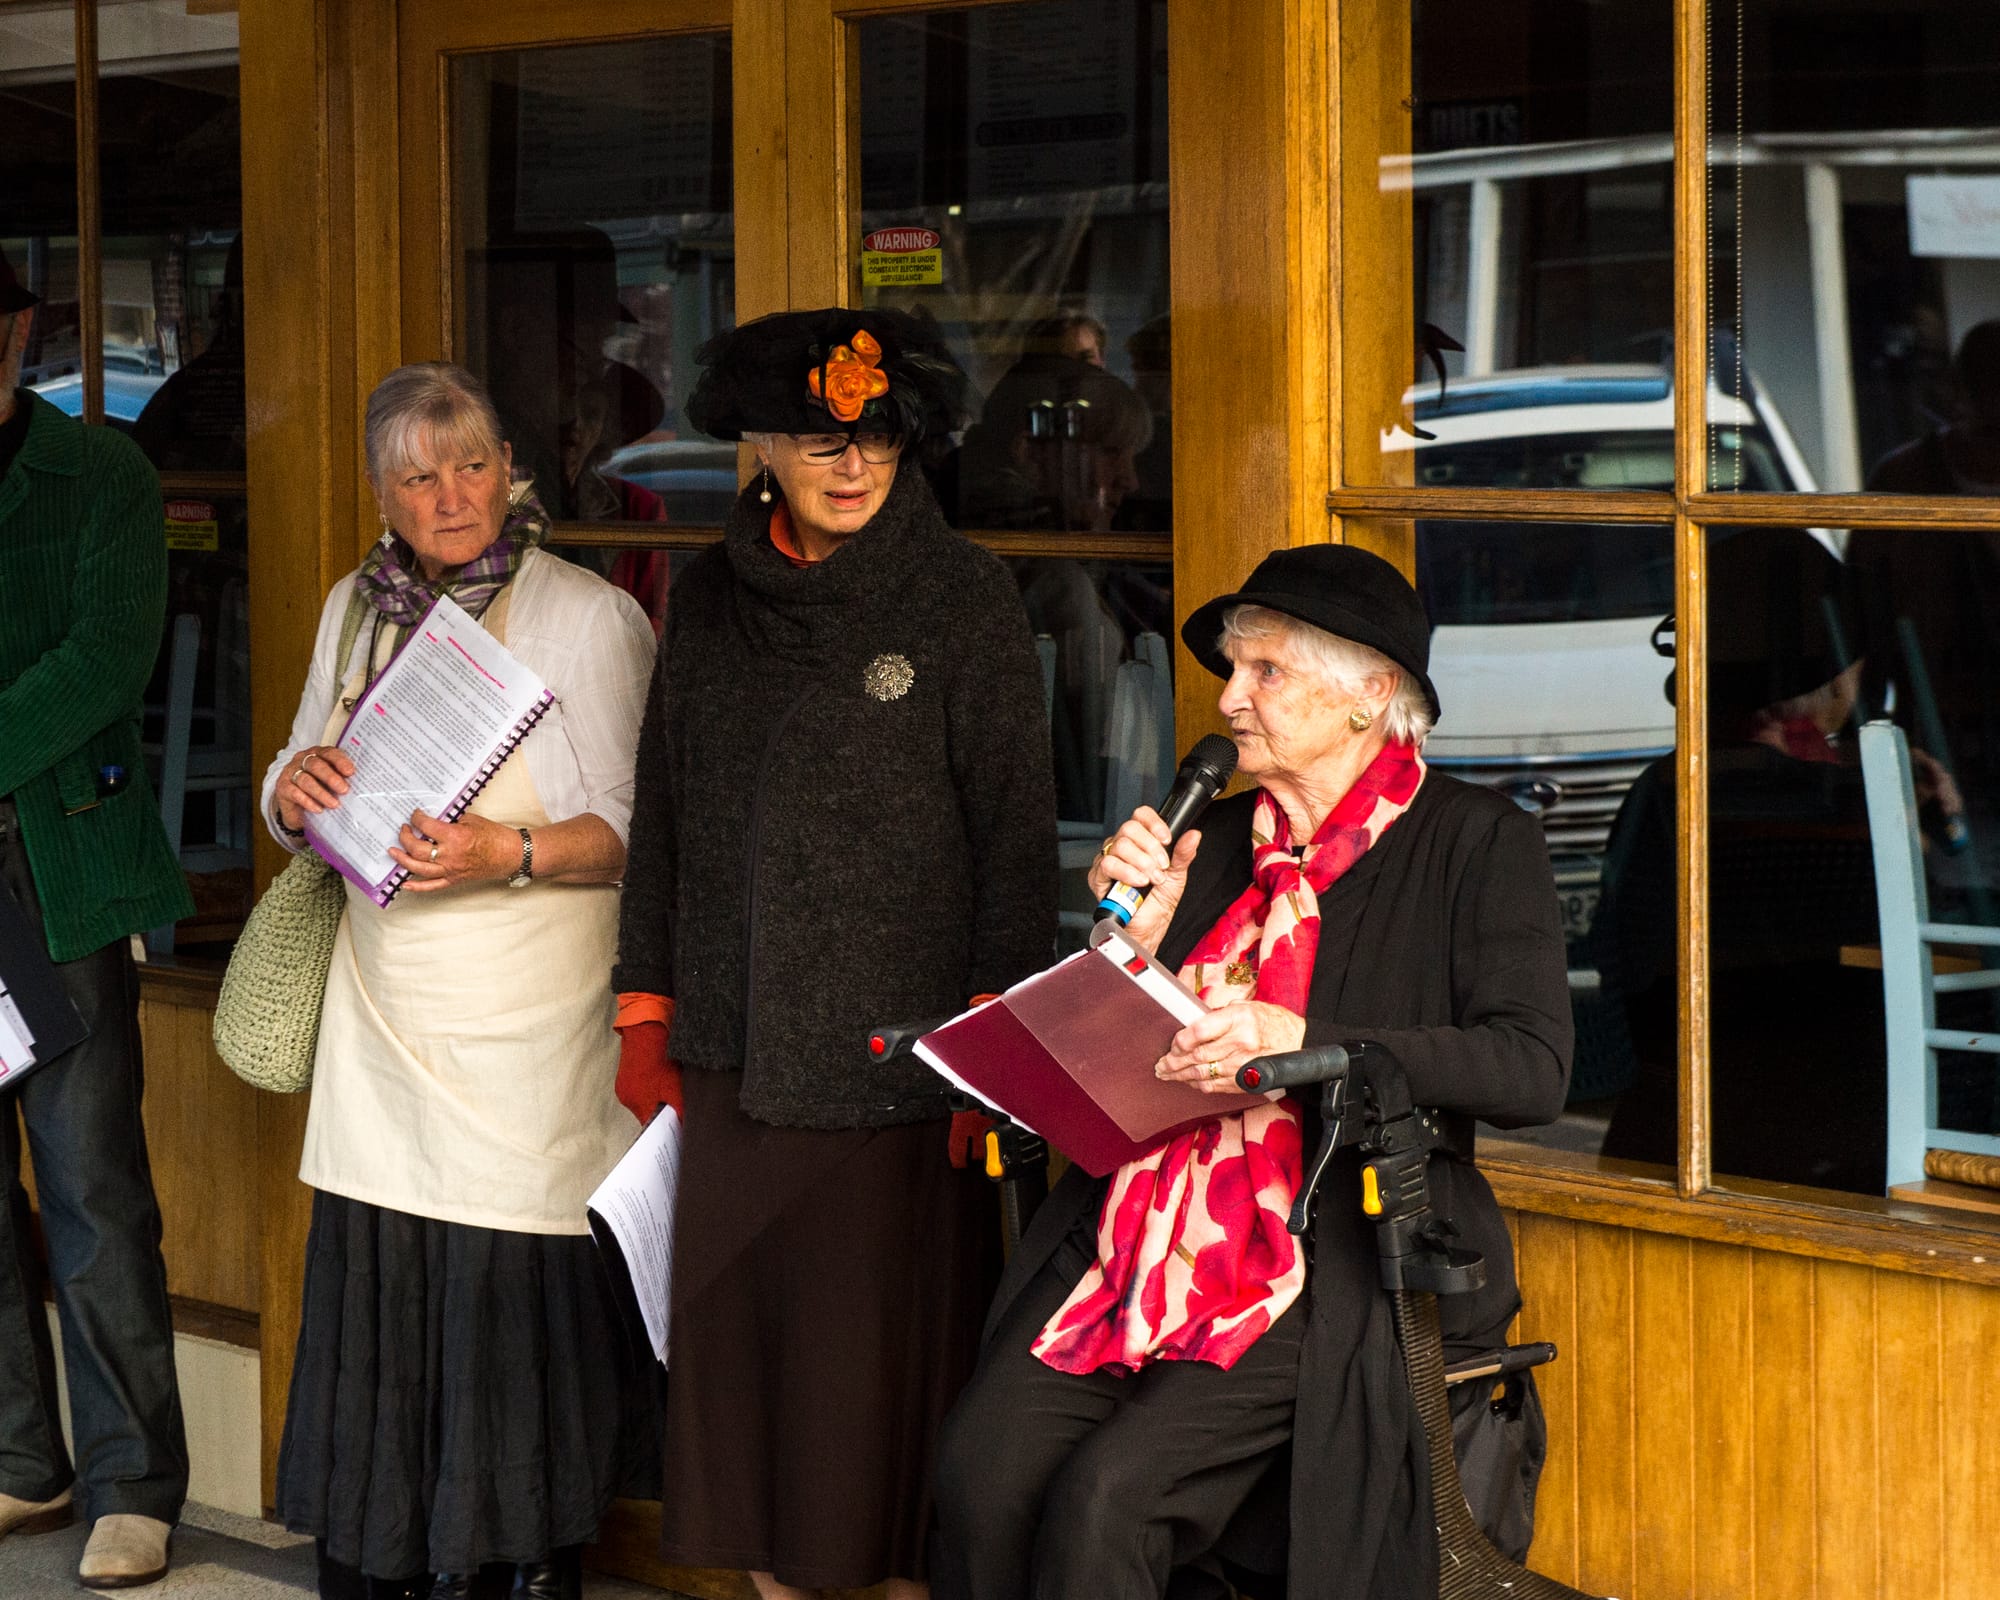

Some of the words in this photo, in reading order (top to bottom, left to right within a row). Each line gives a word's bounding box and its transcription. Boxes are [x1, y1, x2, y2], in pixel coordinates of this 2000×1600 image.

[873, 232, 933, 250] WARNING
[880, 256, 909, 264] PROPERTY
[917, 255, 936, 263] UNDER
[868, 265, 899, 274] CONSTANT
[900, 264, 936, 272] ELECTRONIC
